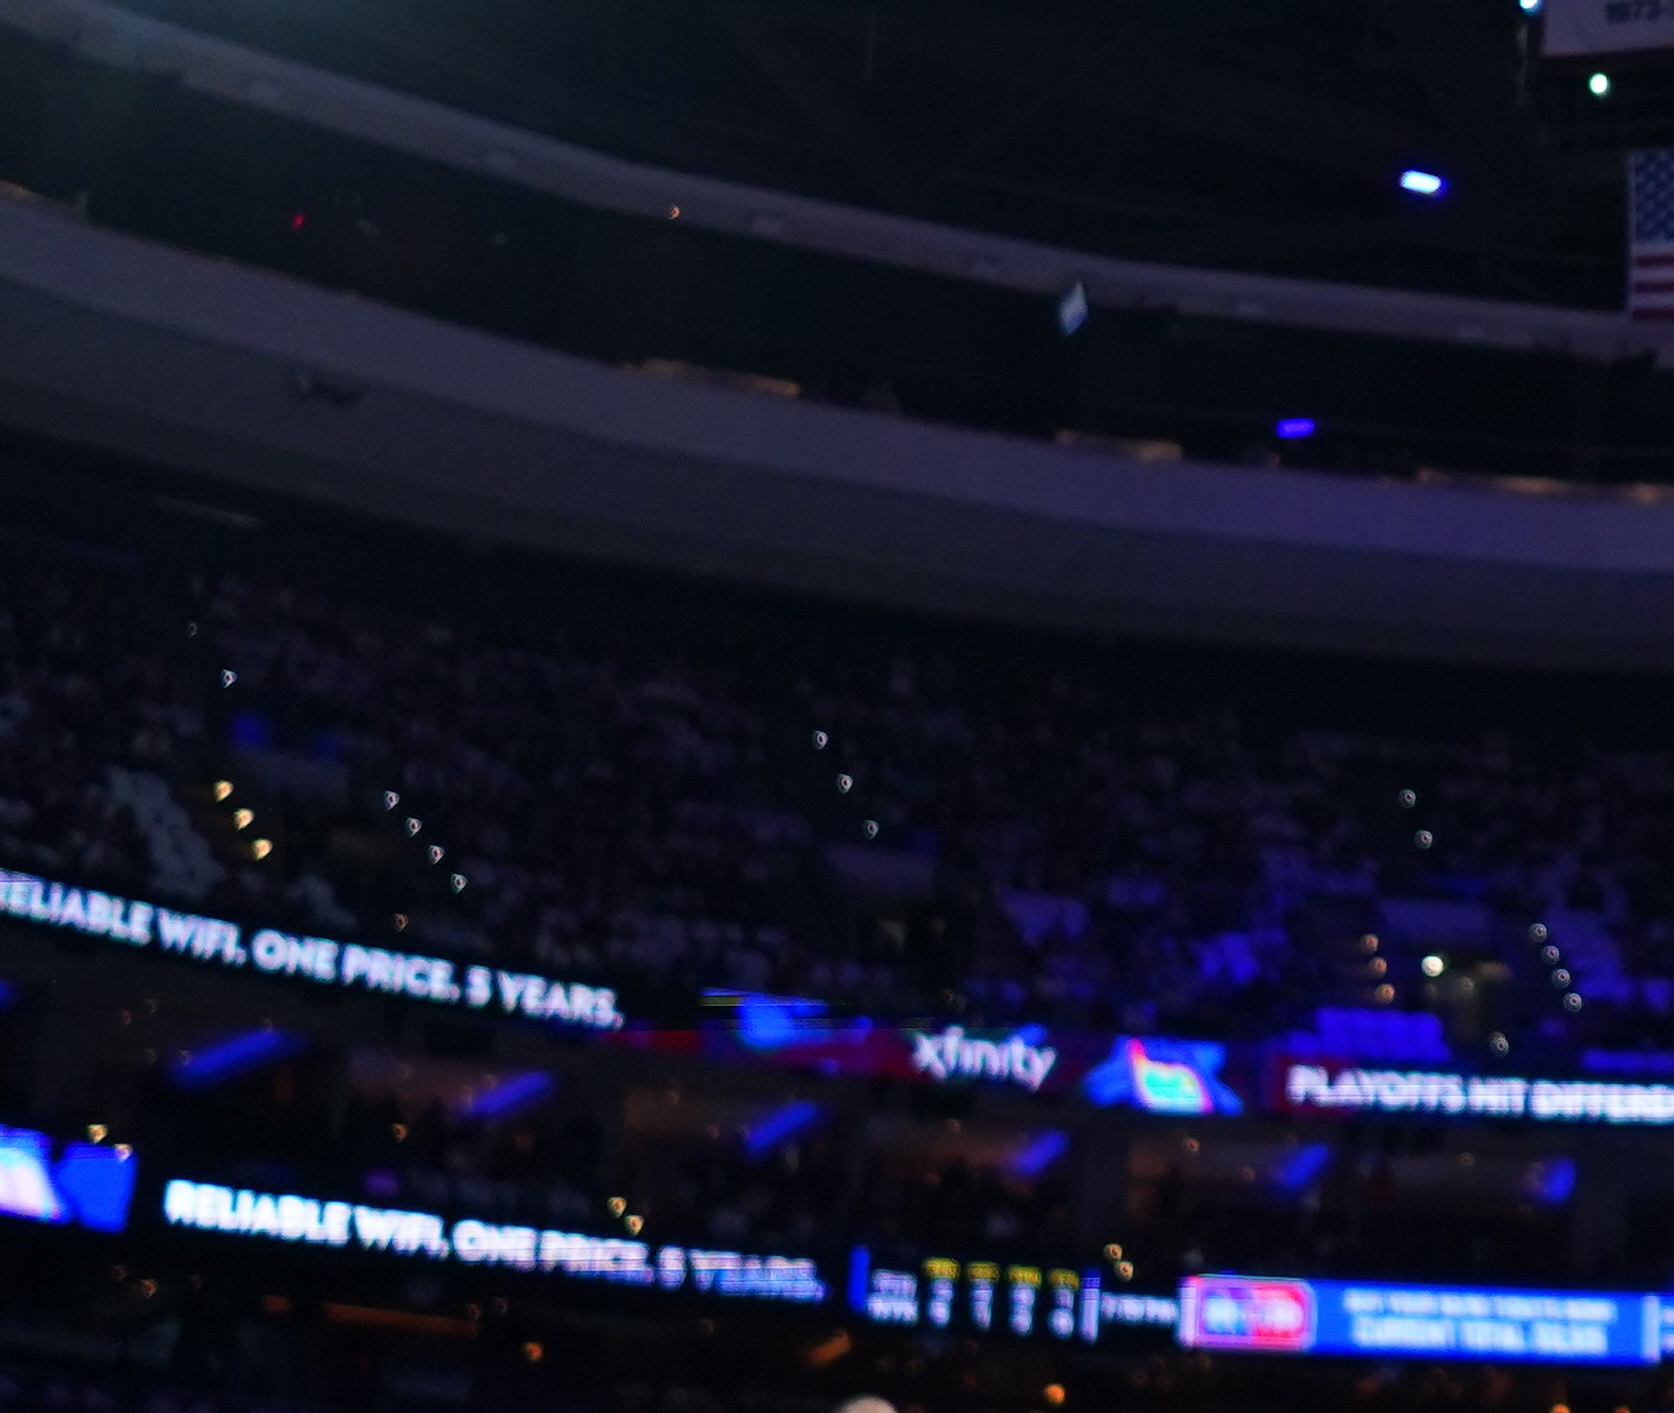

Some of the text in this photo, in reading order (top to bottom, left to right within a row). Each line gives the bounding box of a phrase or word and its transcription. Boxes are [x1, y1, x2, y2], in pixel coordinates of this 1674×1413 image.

[252, 928, 338, 984] ONE
[911, 1026, 1057, 1091] xfinity
[1286, 1064, 1464, 1114] PLAYOFFS
[164, 1179, 537, 1270] RELIABLE ONE
